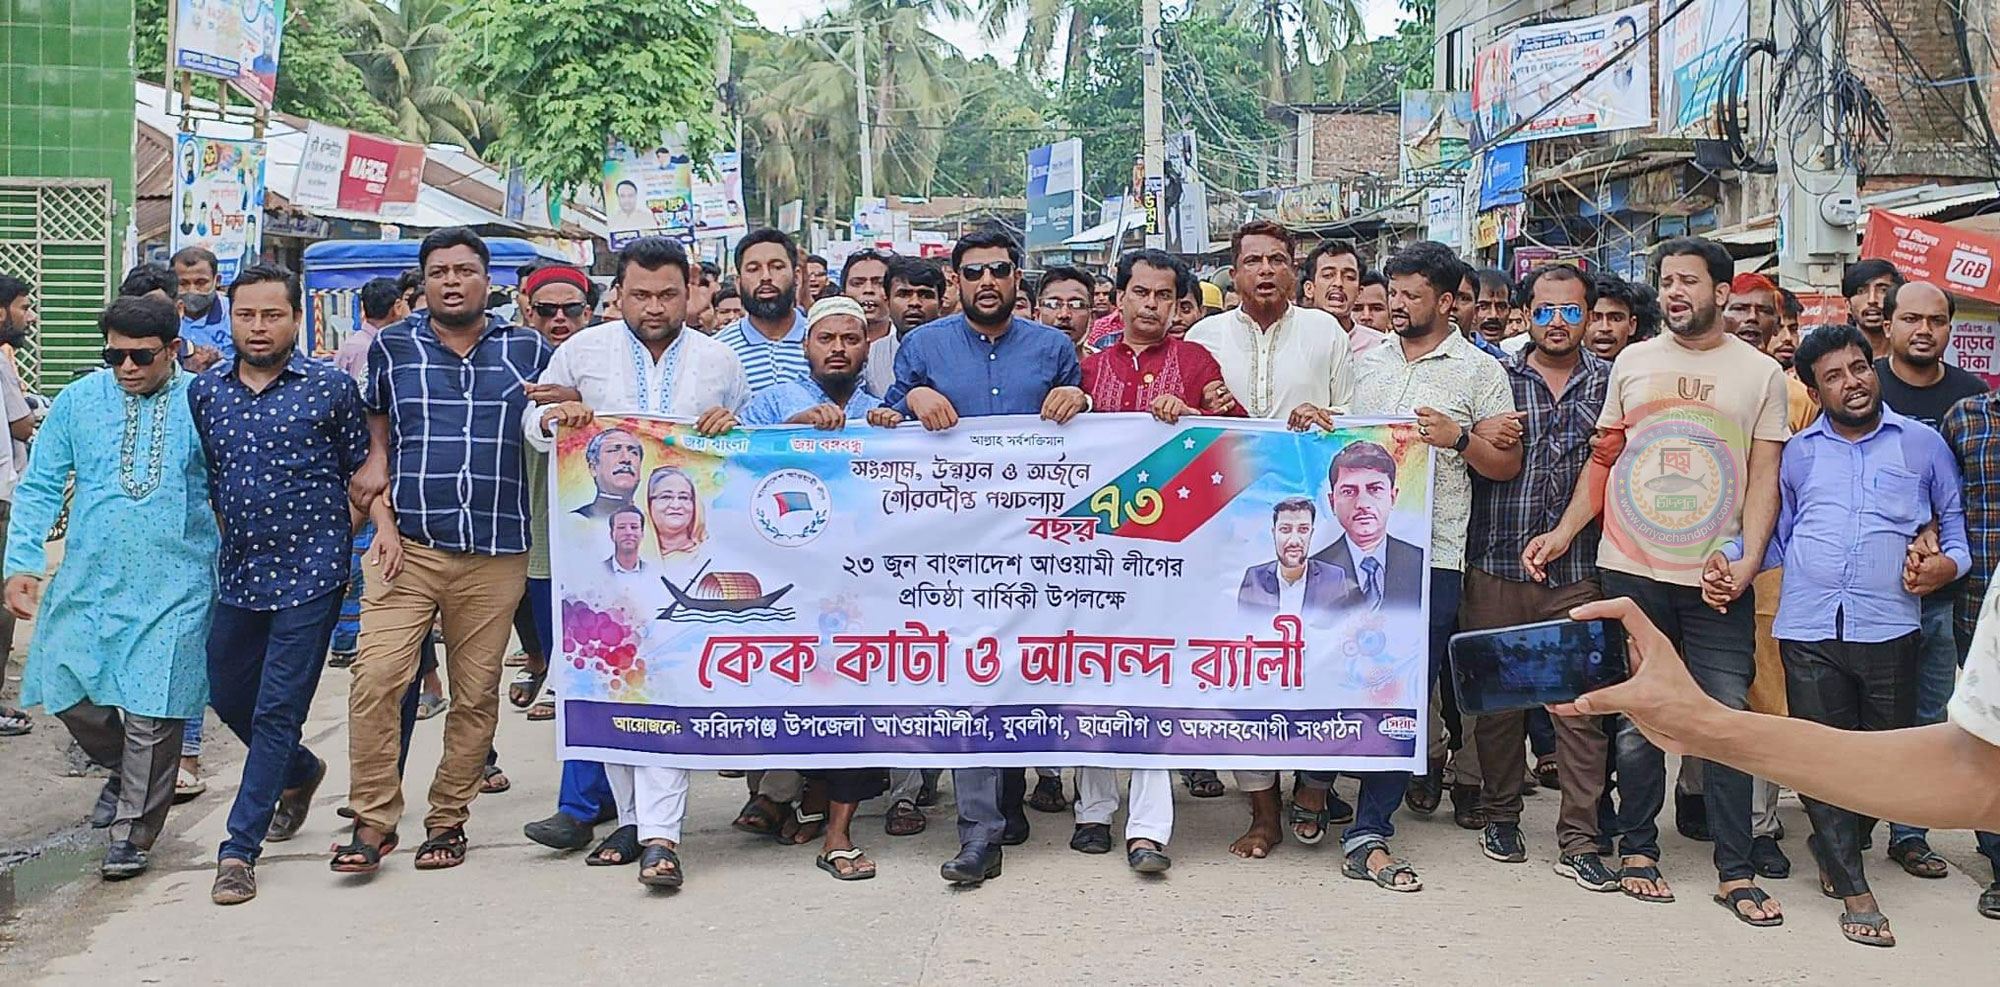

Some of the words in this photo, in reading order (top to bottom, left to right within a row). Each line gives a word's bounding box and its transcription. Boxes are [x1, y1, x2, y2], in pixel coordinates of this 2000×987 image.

[1952, 257, 1988, 279] 7GB
[1952, 335, 1995, 354] বাড়বে
[1957, 351, 1991, 370] টাকা
[1678, 376, 1715, 401] Ur
[683, 436, 706, 451] জয়
[711, 437, 748, 451] বাংলা
[791, 438, 816, 452] জয়
[819, 438, 864, 455] বঙ্গবন্ধু
[970, 436, 1004, 447] আল্লাহ
[1007, 433, 1065, 447] সর্বশক্তিমান
[851, 460, 923, 484] সংগ্রাম,
[932, 455, 994, 482] উন্নয়ন
[1002, 463, 1018, 481] ও
[1027, 452, 1092, 489] অর্জনে
[882, 481, 977, 515] গৌরবদীপ্ত
[986, 490, 1066, 515] পথচলায়
[1090, 485, 1165, 530] ৭৩
[1026, 516, 1099, 545] বছর
[842, 556, 874, 577] ২৩
[883, 555, 917, 580] জুন
[926, 552, 1023, 576] বাংলাদেশ
[1030, 549, 1114, 577] আওয়ামী
[1122, 551, 1185, 578] লীগের
[899, 580, 964, 610] প্রতিষ্ঠা
[973, 581, 1038, 610] বার্ষিকী
[1046, 582, 1127, 611] উপলক্ষে
[698, 636, 819, 689] কেক
[832, 621, 949, 683] কাটা
[965, 636, 1001, 684] ও
[1018, 629, 1176, 685] আনন্দ
[689, 712, 777, 739] ফরিদগঞ্জ
[782, 710, 865, 739] উপজেলা
[871, 708, 995, 742] আওয়ামীলীগ,
[1001, 708, 1071, 742] যুবলীগ,
[1076, 709, 1150, 739] ছাত্রলীগ
[1156, 718, 1174, 737] ও
[1179, 712, 1289, 743] অঙ্গসহযোগী
[1294, 711, 1363, 742] সংগঠন
